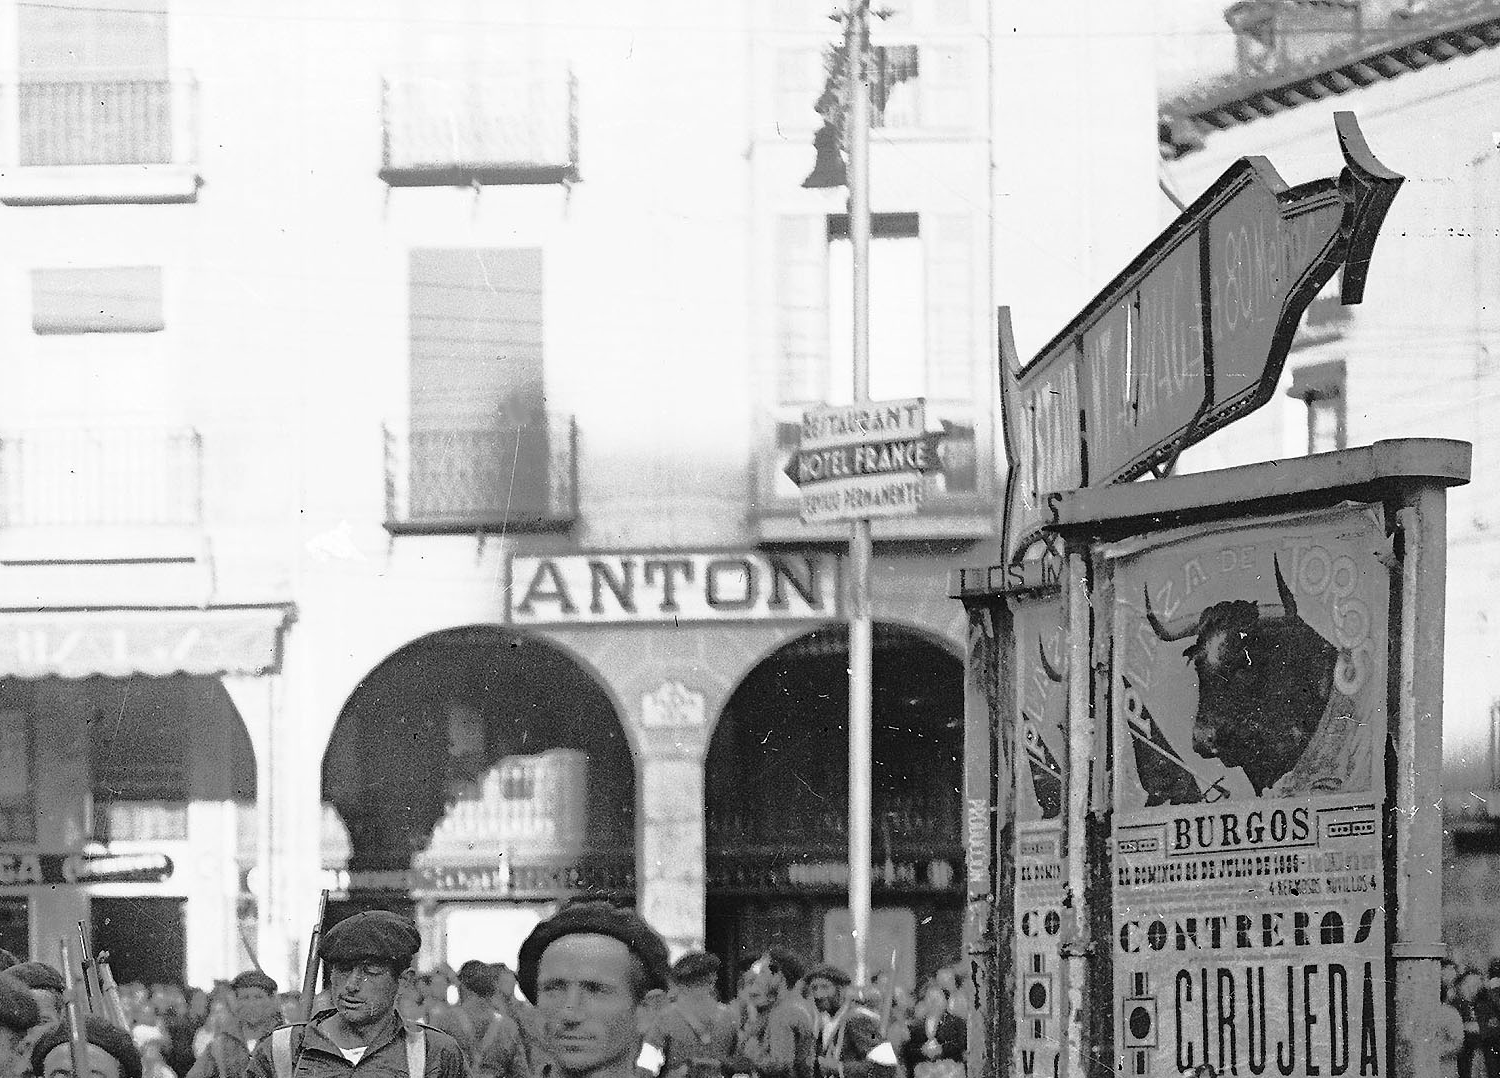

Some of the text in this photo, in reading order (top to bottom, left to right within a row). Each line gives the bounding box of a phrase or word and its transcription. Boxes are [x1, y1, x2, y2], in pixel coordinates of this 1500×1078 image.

[854, 441, 927, 474] FRANCE
[515, 556, 825, 614] ANTON
[1173, 808, 1311, 850] BURGOS
[1255, 856, 1270, 876] DE
[1119, 908, 1377, 952] CONTRERAS
[1175, 961, 1379, 1077] CIRUJEDA
